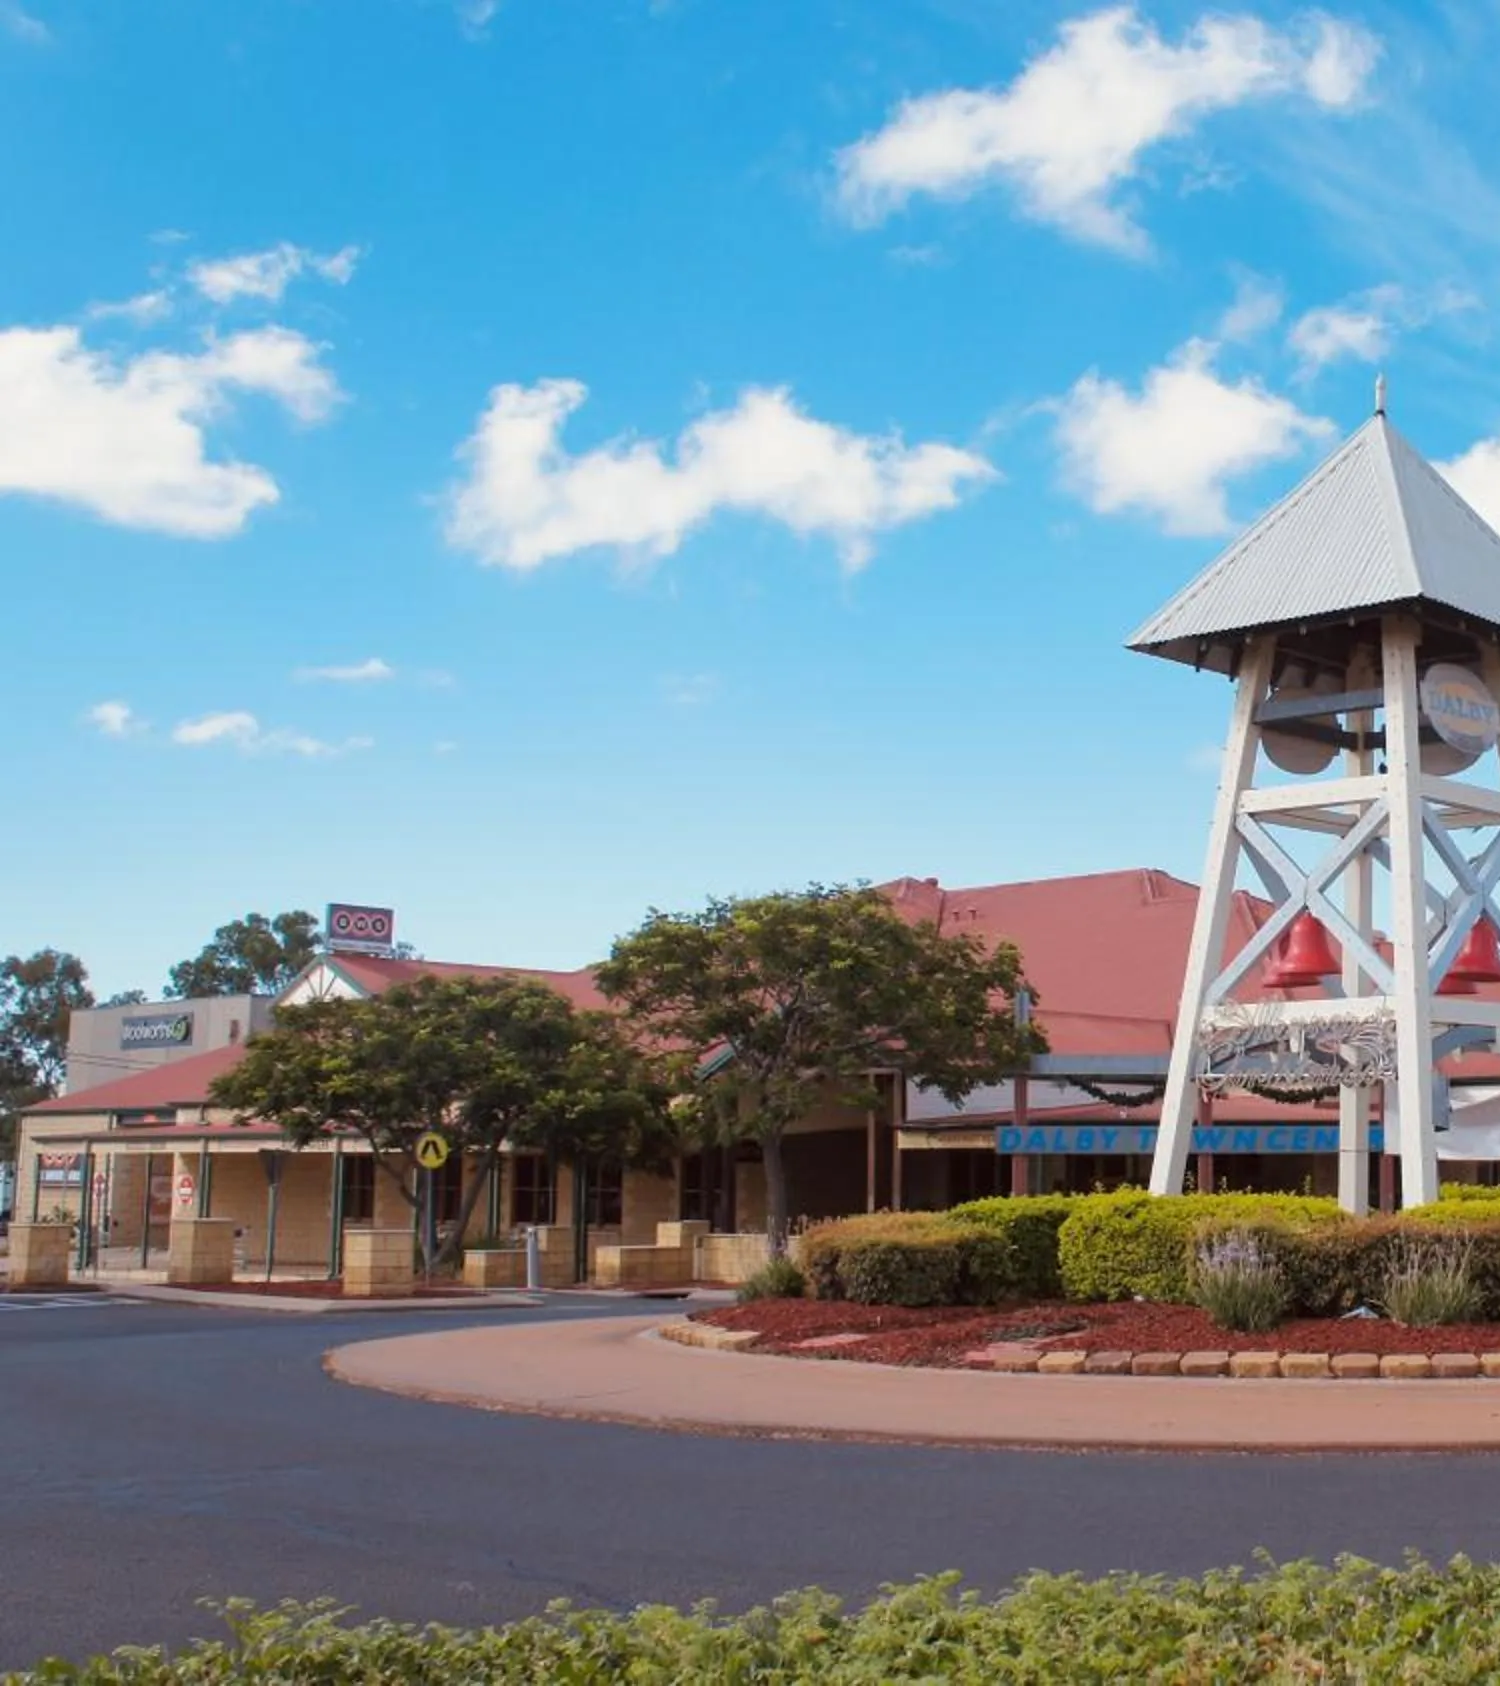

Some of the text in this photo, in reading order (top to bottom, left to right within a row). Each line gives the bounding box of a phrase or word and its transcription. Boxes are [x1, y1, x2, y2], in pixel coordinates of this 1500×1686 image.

[1429, 691, 1495, 719] DALBY
[1001, 1128, 1118, 1150] DALBY
[1137, 1128, 1258, 1151] TWN
